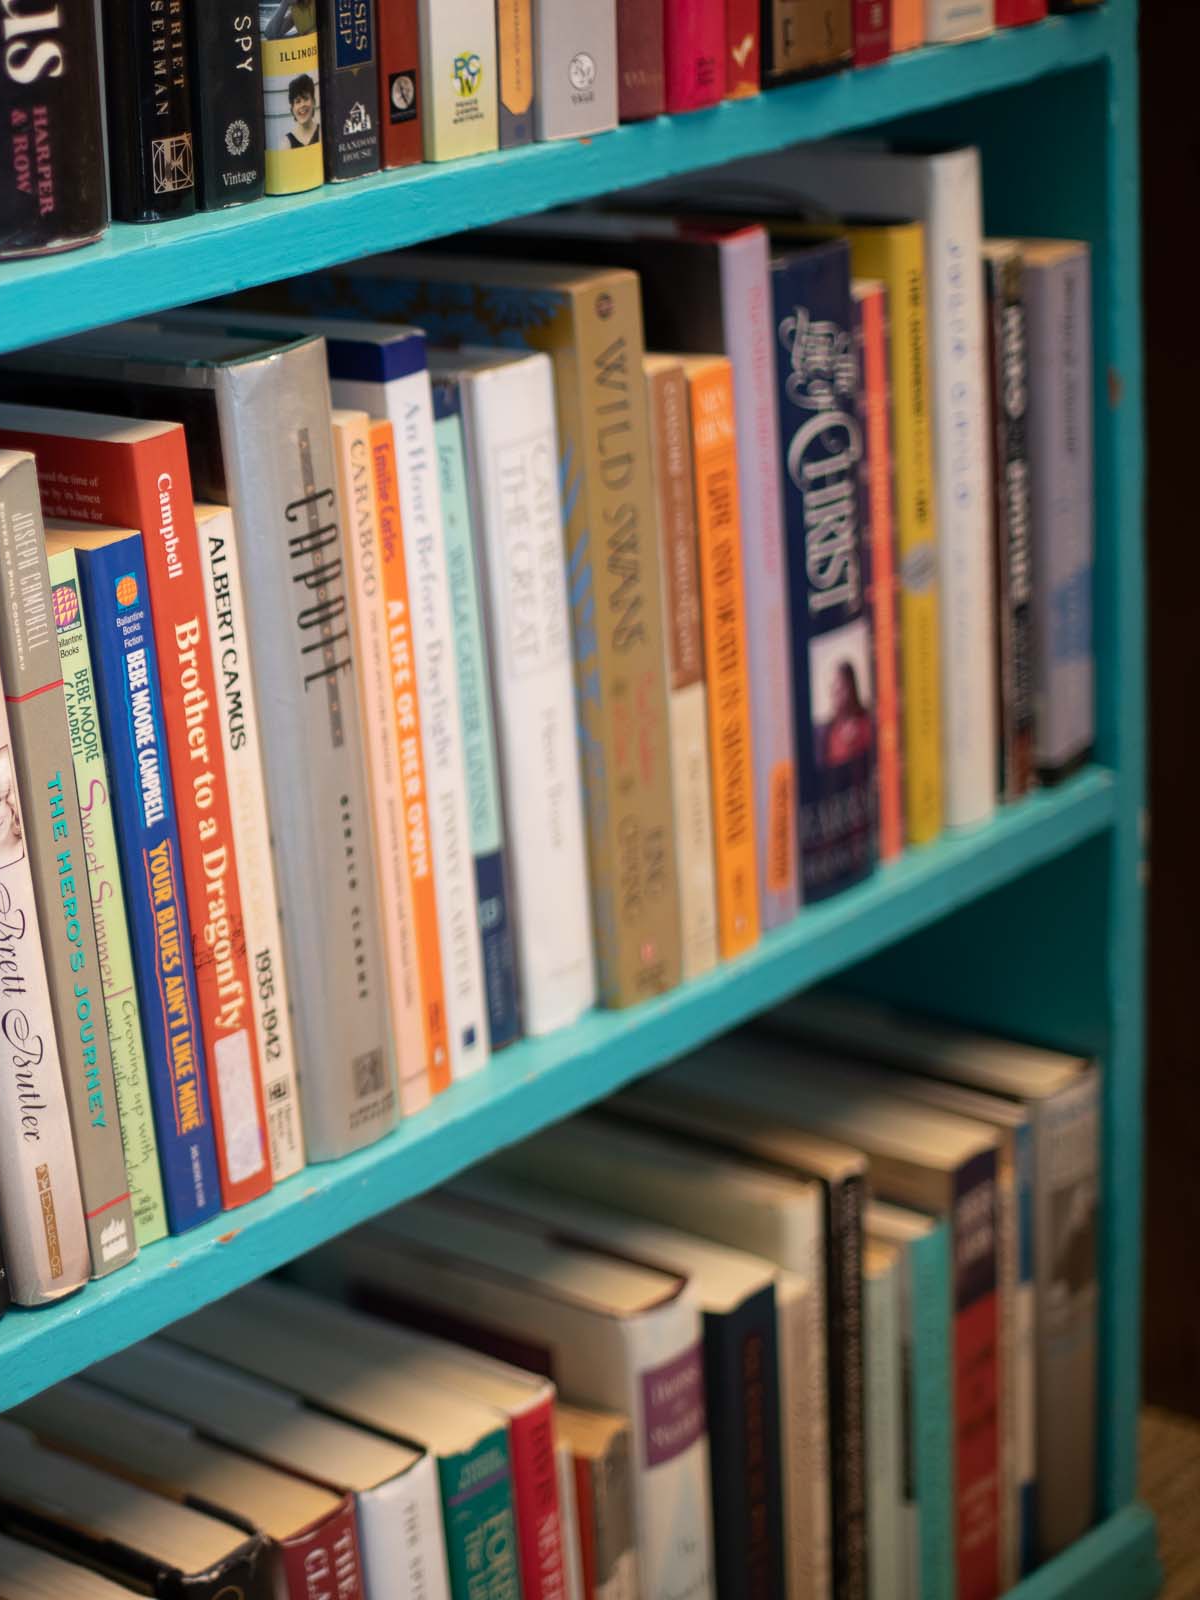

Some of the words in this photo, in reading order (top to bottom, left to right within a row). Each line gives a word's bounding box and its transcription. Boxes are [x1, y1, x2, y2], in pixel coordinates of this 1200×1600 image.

[234, 15, 254, 72] SPY
[279, 45, 318, 63] ILLINOIS
[13, 133, 33, 193] ROW
[33, 104, 55, 216] HARPER
[222, 169, 257, 187] Vintage
[593, 336, 635, 490] WILD
[11, 512, 40, 571] JOSEPH
[156, 472, 185, 581] Campbell
[350, 437, 377, 598] CARABOO
[207, 534, 236, 648] ALBERT
[284, 486, 353, 692] CAPOTE
[415, 533, 437, 630] Before
[603, 502, 645, 651] SWANS
[18, 571, 49, 653] CAMPBELL
[116, 610, 145, 628] Ballantine
[122, 622, 141, 636] Books
[123, 633, 144, 649] Fiction
[387, 600, 405, 621] A
[60, 645, 80, 659] Books
[126, 647, 149, 692] BEBE
[390, 625, 411, 688] LIFE
[74, 668, 89, 704] BEBE
[174, 615, 210, 764] Brother
[219, 648, 247, 753] CAMUS
[397, 692, 415, 731] OF
[425, 639, 452, 768] Daylight
[80, 705, 100, 764] MOORE
[131, 688, 156, 749] MOORE
[137, 747, 165, 828] CAMPBELL
[193, 767, 213, 809] to
[401, 736, 420, 798] HER
[48, 770, 70, 842] THE
[197, 816, 217, 842] a
[406, 801, 428, 879] OWN
[148, 839, 172, 906] YOUR
[56, 849, 86, 972] HERO'S
[155, 904, 182, 975] BLUES
[202, 844, 246, 1030] Dragonfly
[164, 974, 188, 1029] AIN'T
[253, 947, 283, 1062] 1935-1942
[72, 982, 108, 1129] JOURNEY
[121, 1000, 139, 1084] Growing
[172, 1026, 191, 1076] LIKE
[1, 1007, 48, 1142] Butler
[132, 1088, 145, 1117] up
[177, 1072, 202, 1134] MINE
[138, 1120, 155, 1165] with
